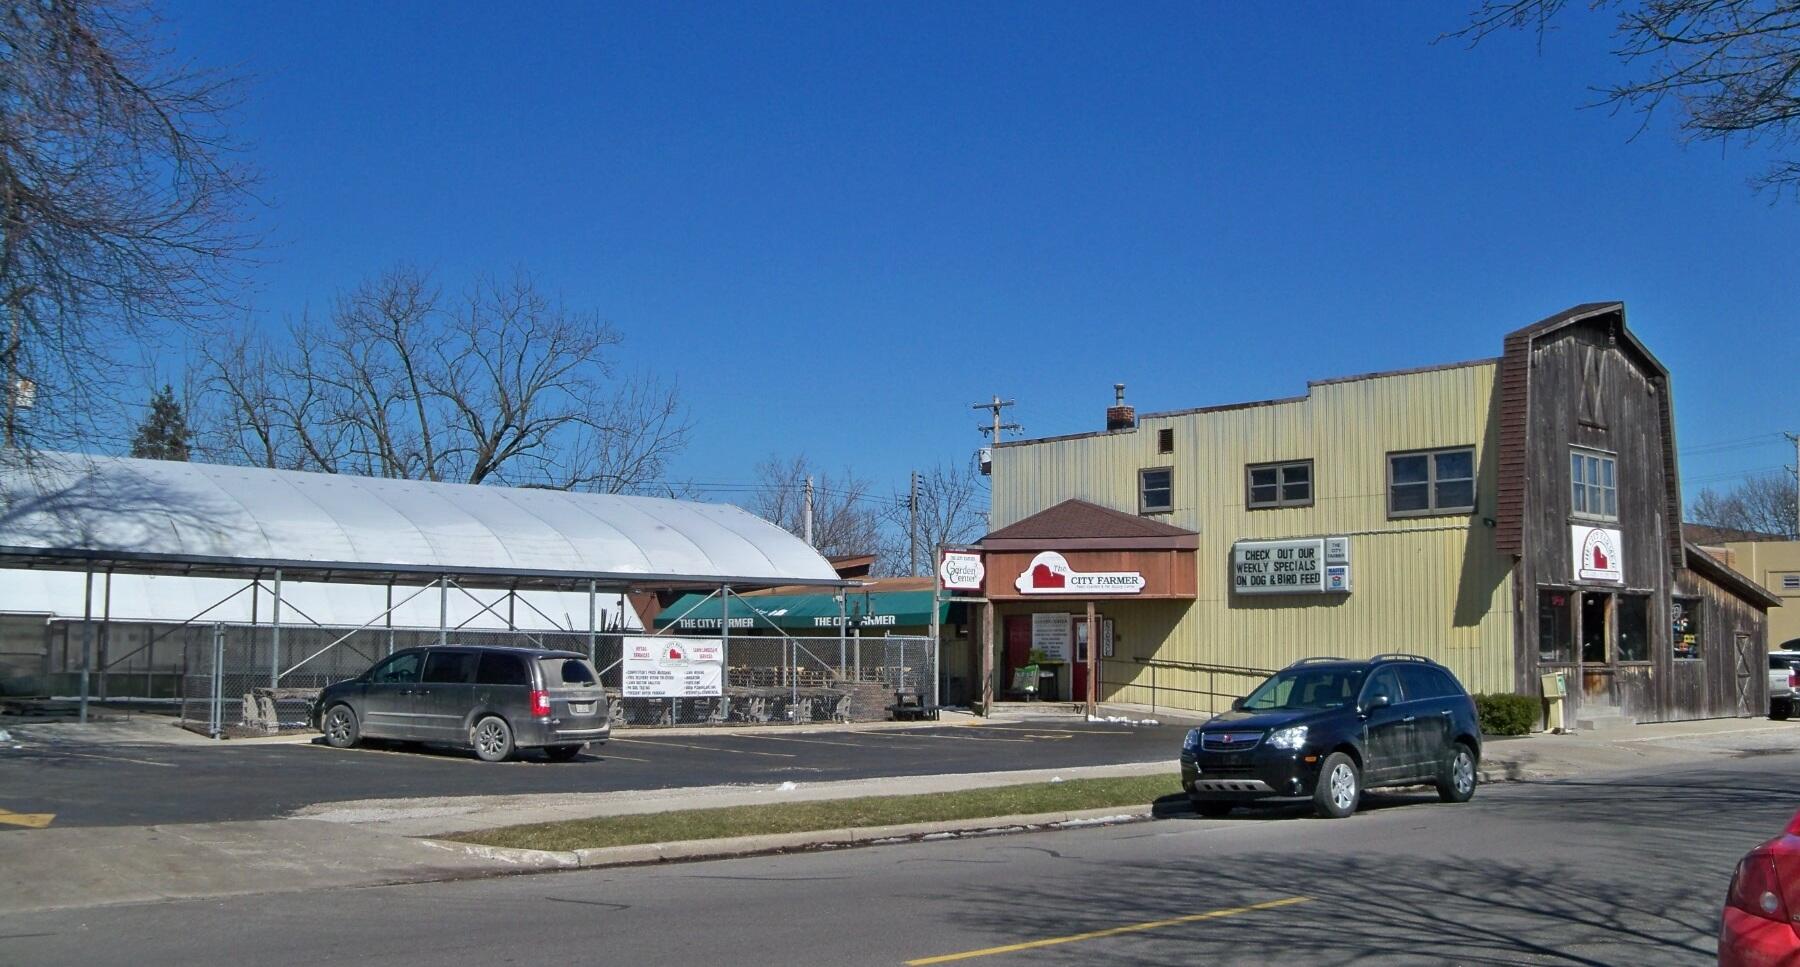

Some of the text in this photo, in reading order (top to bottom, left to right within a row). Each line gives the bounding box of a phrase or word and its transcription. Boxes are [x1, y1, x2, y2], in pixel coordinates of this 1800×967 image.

[1245, 548, 1315, 561] CHECK OUT OUR
[946, 560, 977, 576] Garden
[1053, 564, 1067, 573] The
[1236, 560, 1316, 573] WEEKLY SPECIALS
[950, 573, 977, 584] Center
[1071, 576, 1139, 585] CITY FARMER
[1236, 573, 1321, 586] ON DOG & BIRD FEED
[680, 618, 754, 628] THE CITY FRMER
[814, 616, 832, 627] THE
[857, 615, 896, 625] ARMER
